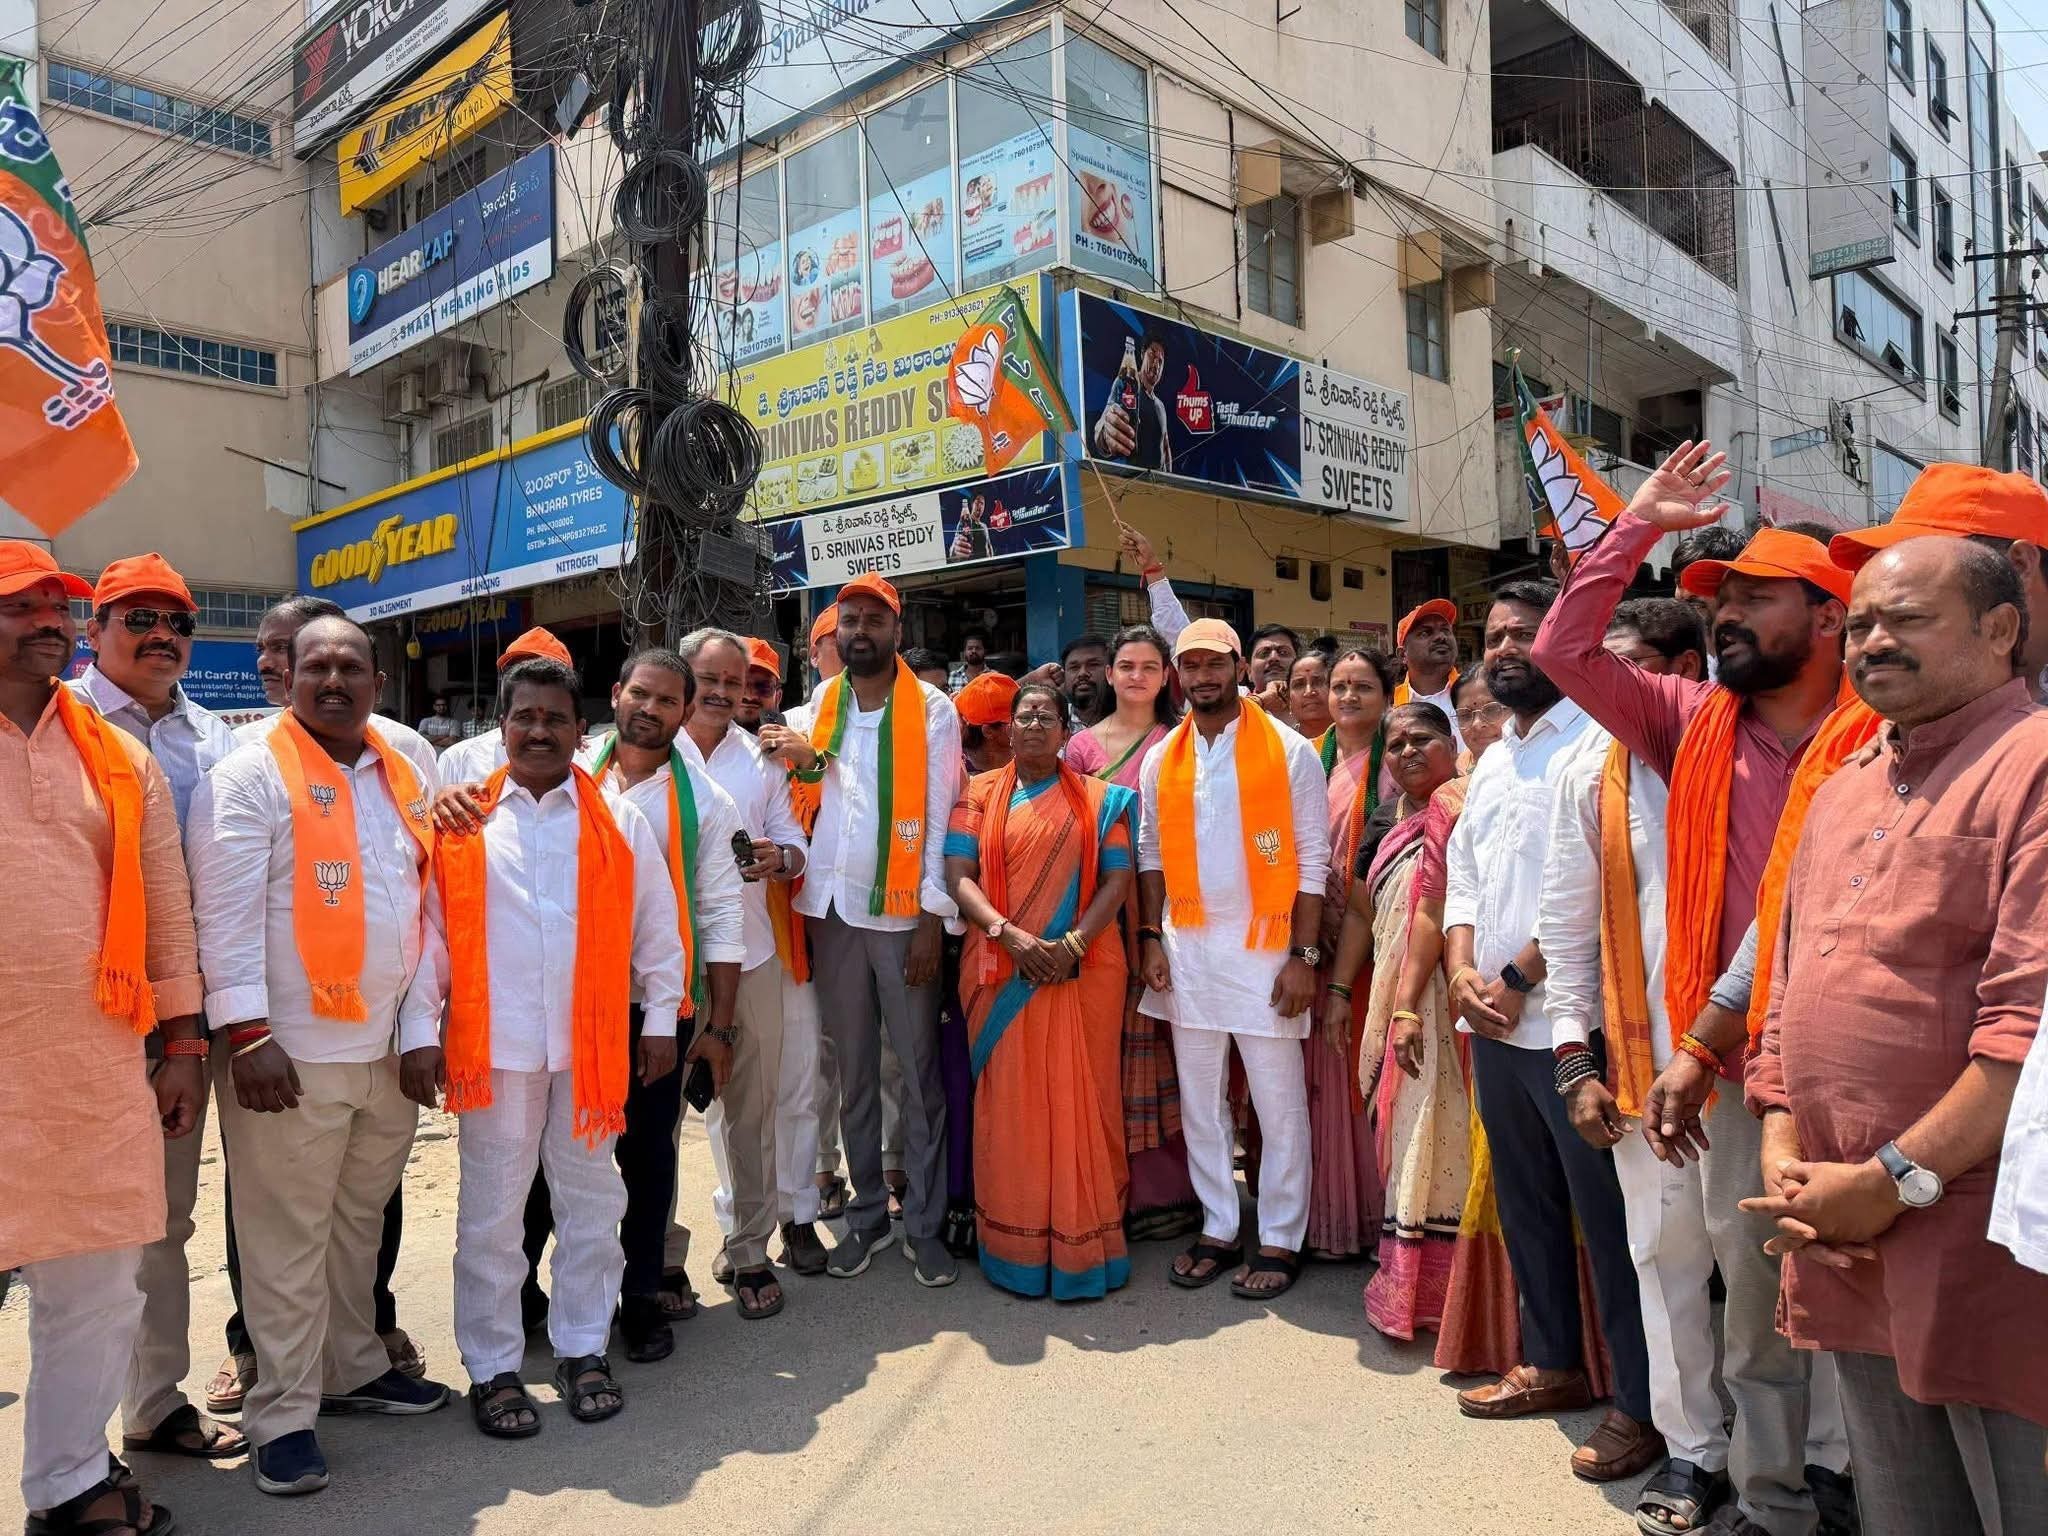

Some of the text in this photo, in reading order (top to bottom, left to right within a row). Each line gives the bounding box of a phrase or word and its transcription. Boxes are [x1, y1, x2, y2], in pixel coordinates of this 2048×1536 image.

[450, 97, 485, 129] ONTROL
[1070, 149, 1146, 188] Spandana Dental Care
[378, 229, 456, 297] HEARZAP
[1075, 233, 1088, 249] PH
[1096, 241, 1148, 270] 7601075919
[400, 260, 530, 340] SMART HEARING AIDS
[1177, 393, 1208, 424] Thums UP
[1216, 401, 1240, 414] Taste
[1304, 370, 1405, 431] డి. శ్రీనివాస్ రెడ్డి స్వీట్స్
[760, 411, 840, 460] RINIVAS
[843, 387, 918, 443] REDDY
[1227, 411, 1276, 428] Thunder
[1304, 418, 1406, 475] D. SRINIVAS REDDY
[525, 468, 572, 496] బంజారా
[1322, 465, 1393, 511] SWEETS
[526, 486, 603, 518] BANJARA TYRES
[823, 503, 918, 537] డి. శ్రీనివాస్ రెడ్డి స్వీట్స్
[311, 513, 458, 588] GOODYEAR
[811, 525, 935, 562] D. SRINIVAS REDDY
[556, 554, 599, 573] NITROGEN
[847, 552, 901, 577] SWEETS
[378, 598, 412, 615] ALIGNMENT
[201, 682, 233, 691] instantly
[204, 670, 239, 681] Card?
[236, 691, 256, 700] Bajaj
